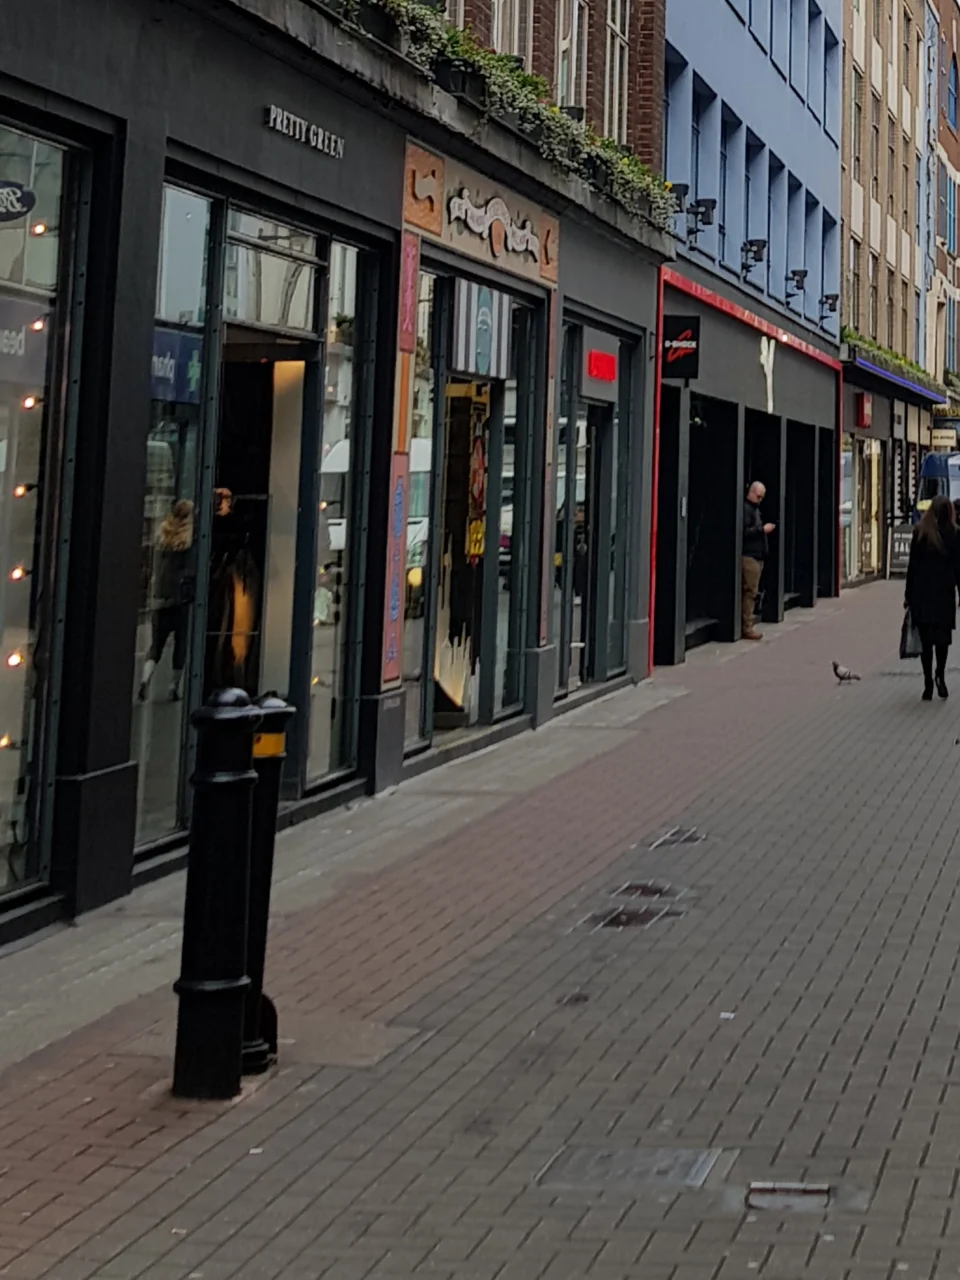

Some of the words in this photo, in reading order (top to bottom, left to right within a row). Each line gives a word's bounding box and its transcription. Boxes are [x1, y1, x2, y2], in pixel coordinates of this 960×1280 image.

[269, 104, 308, 142] PRETTY
[310, 124, 345, 159] GREEN
[894, 541, 911, 553] SAL
